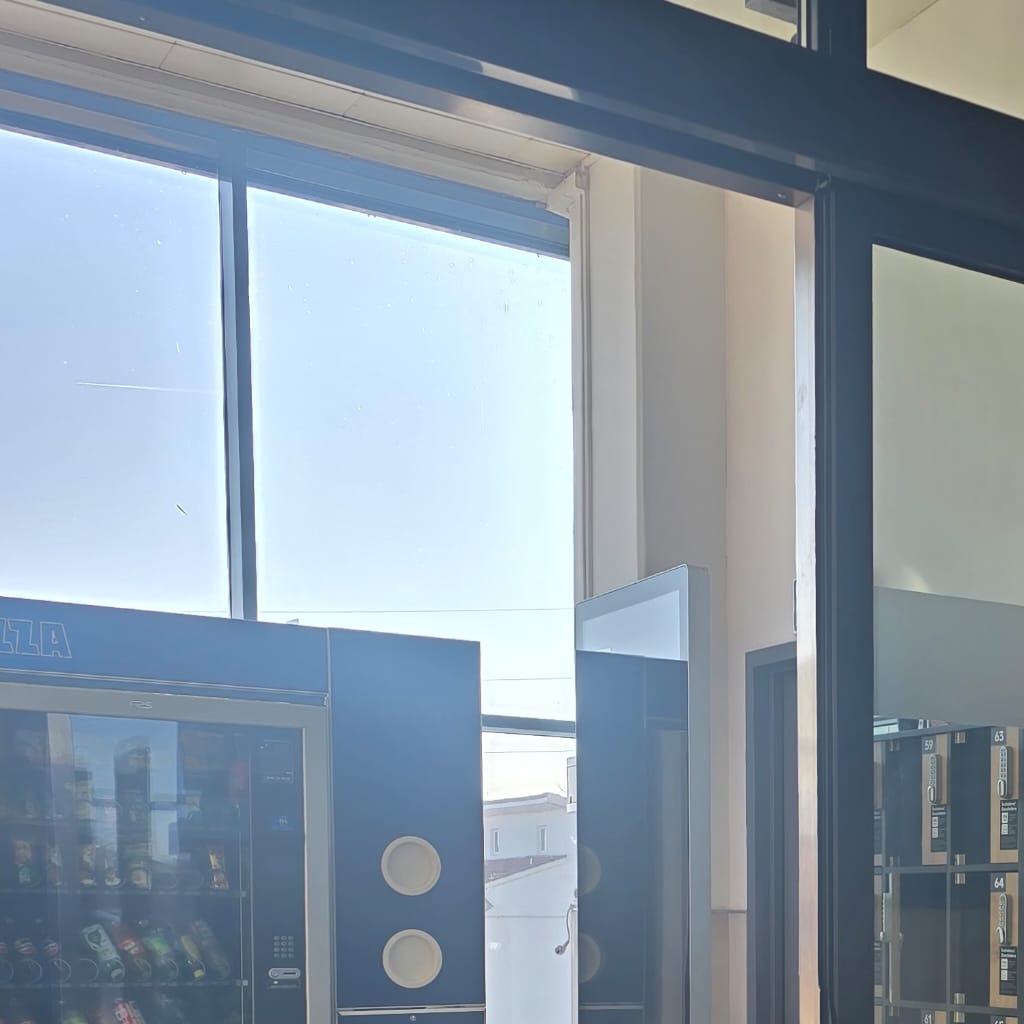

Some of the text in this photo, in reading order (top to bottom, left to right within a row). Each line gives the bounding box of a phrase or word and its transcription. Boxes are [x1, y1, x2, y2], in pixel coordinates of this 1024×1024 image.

[924, 739, 934, 751] 59
[994, 877, 1005, 889] 64
[924, 1014, 932, 1024] 61
